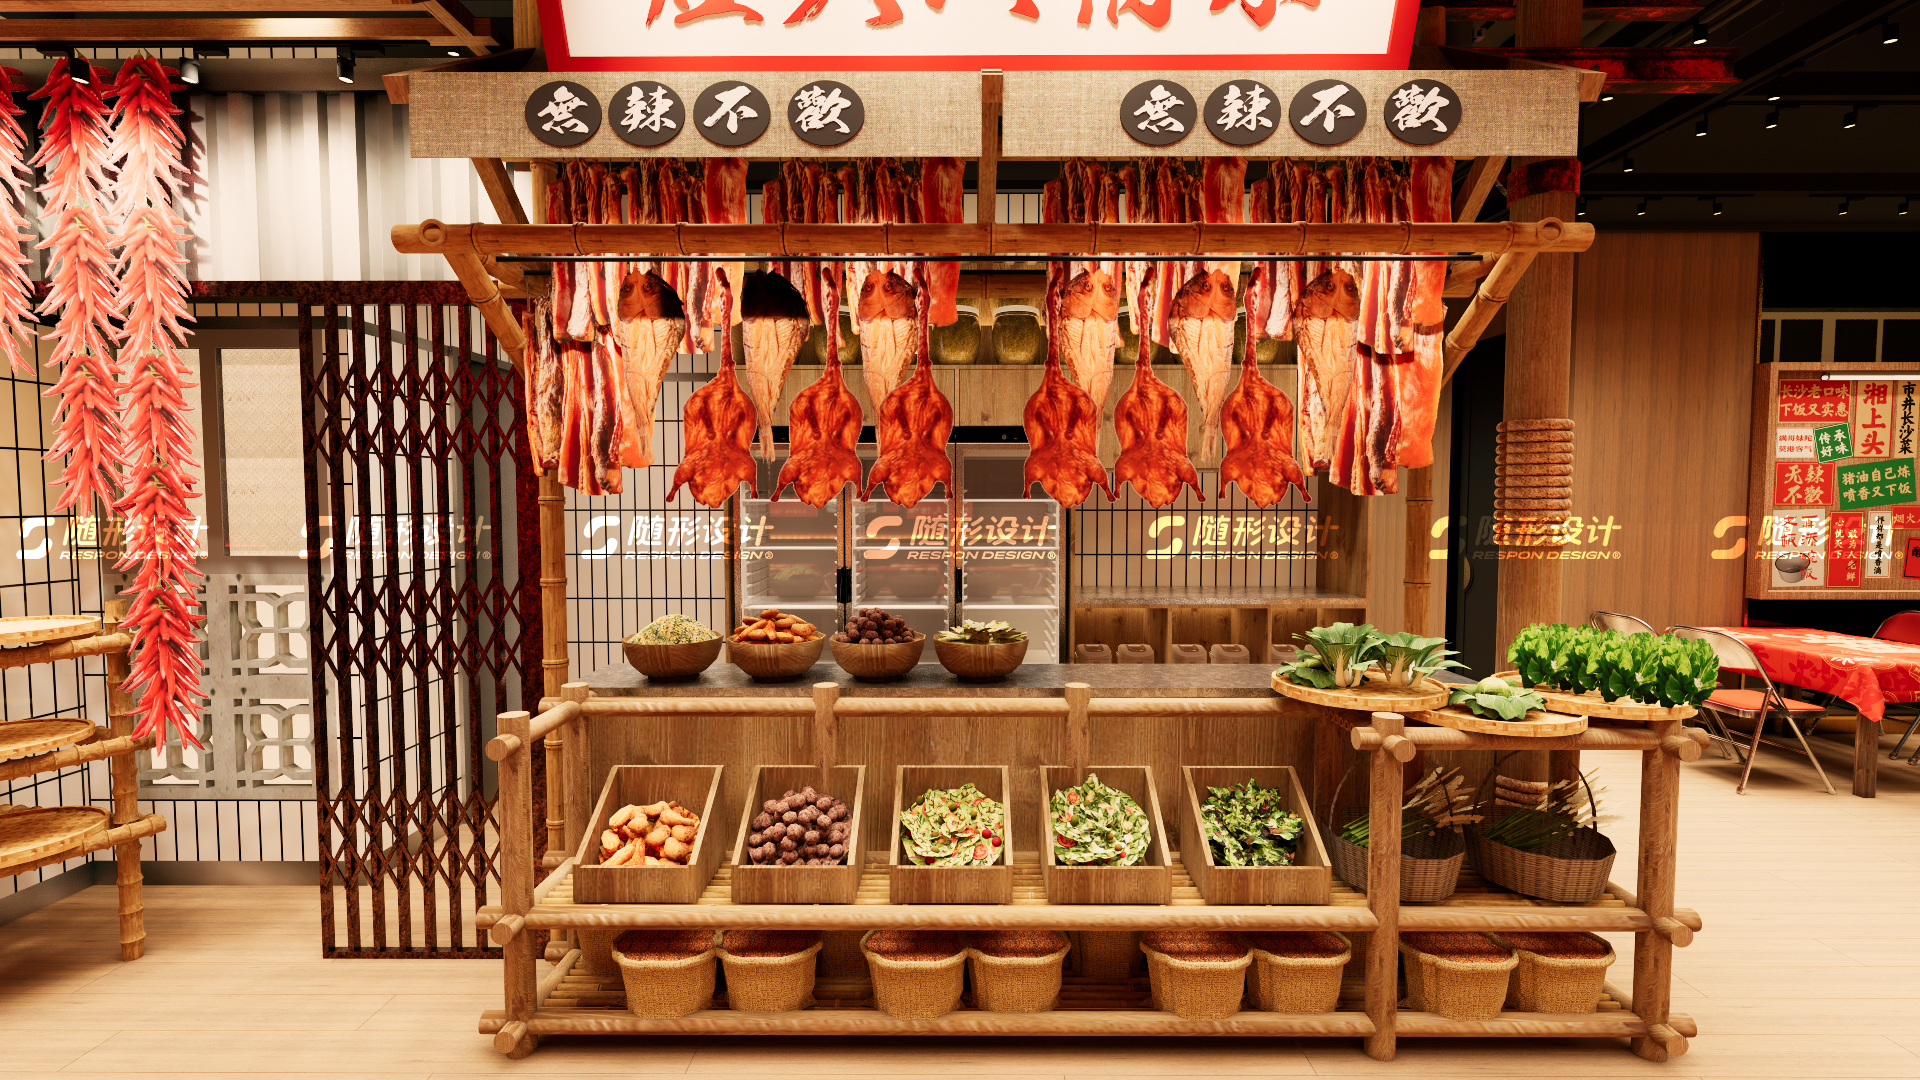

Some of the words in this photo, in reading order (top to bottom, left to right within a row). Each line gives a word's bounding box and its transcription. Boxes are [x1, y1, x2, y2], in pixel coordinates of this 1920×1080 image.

[537, 85, 852, 135] 無辣不歡
[1133, 83, 1450, 134] 無辣不歡
[1779, 402, 1849, 417] 下饭又实惠
[1781, 384, 1850, 399] 长沙老口味
[1860, 382, 1888, 455] 湘上头
[1898, 381, 1917, 455] 市井长沙菜
[1842, 464, 1911, 486] 猪油自己炼
[1843, 481, 1913, 503] 喷香又下饭
